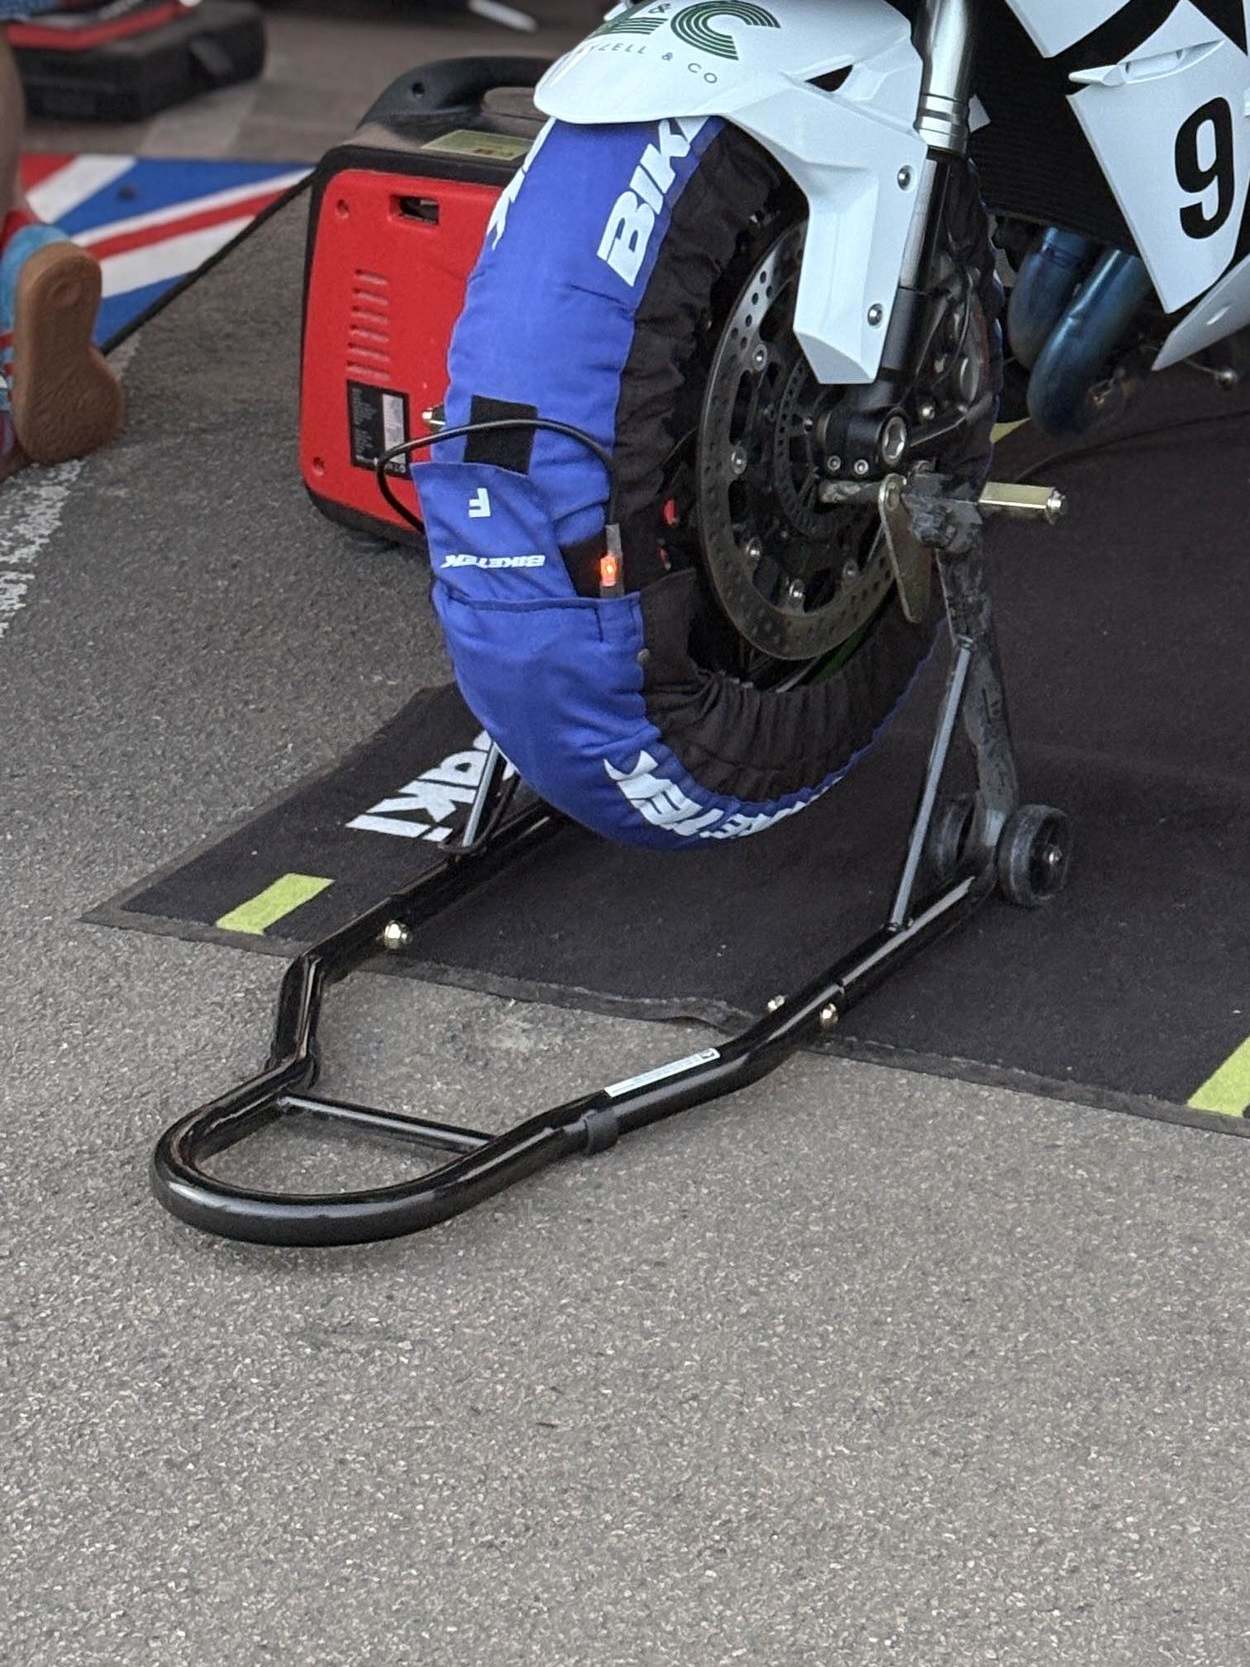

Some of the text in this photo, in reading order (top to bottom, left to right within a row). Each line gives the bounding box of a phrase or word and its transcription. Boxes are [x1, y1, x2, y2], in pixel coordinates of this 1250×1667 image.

[687, 62, 718, 85] CO
[1174, 97, 1236, 240] 9
[468, 488, 491, 518] F
[440, 554, 545, 569] BIKETEK
